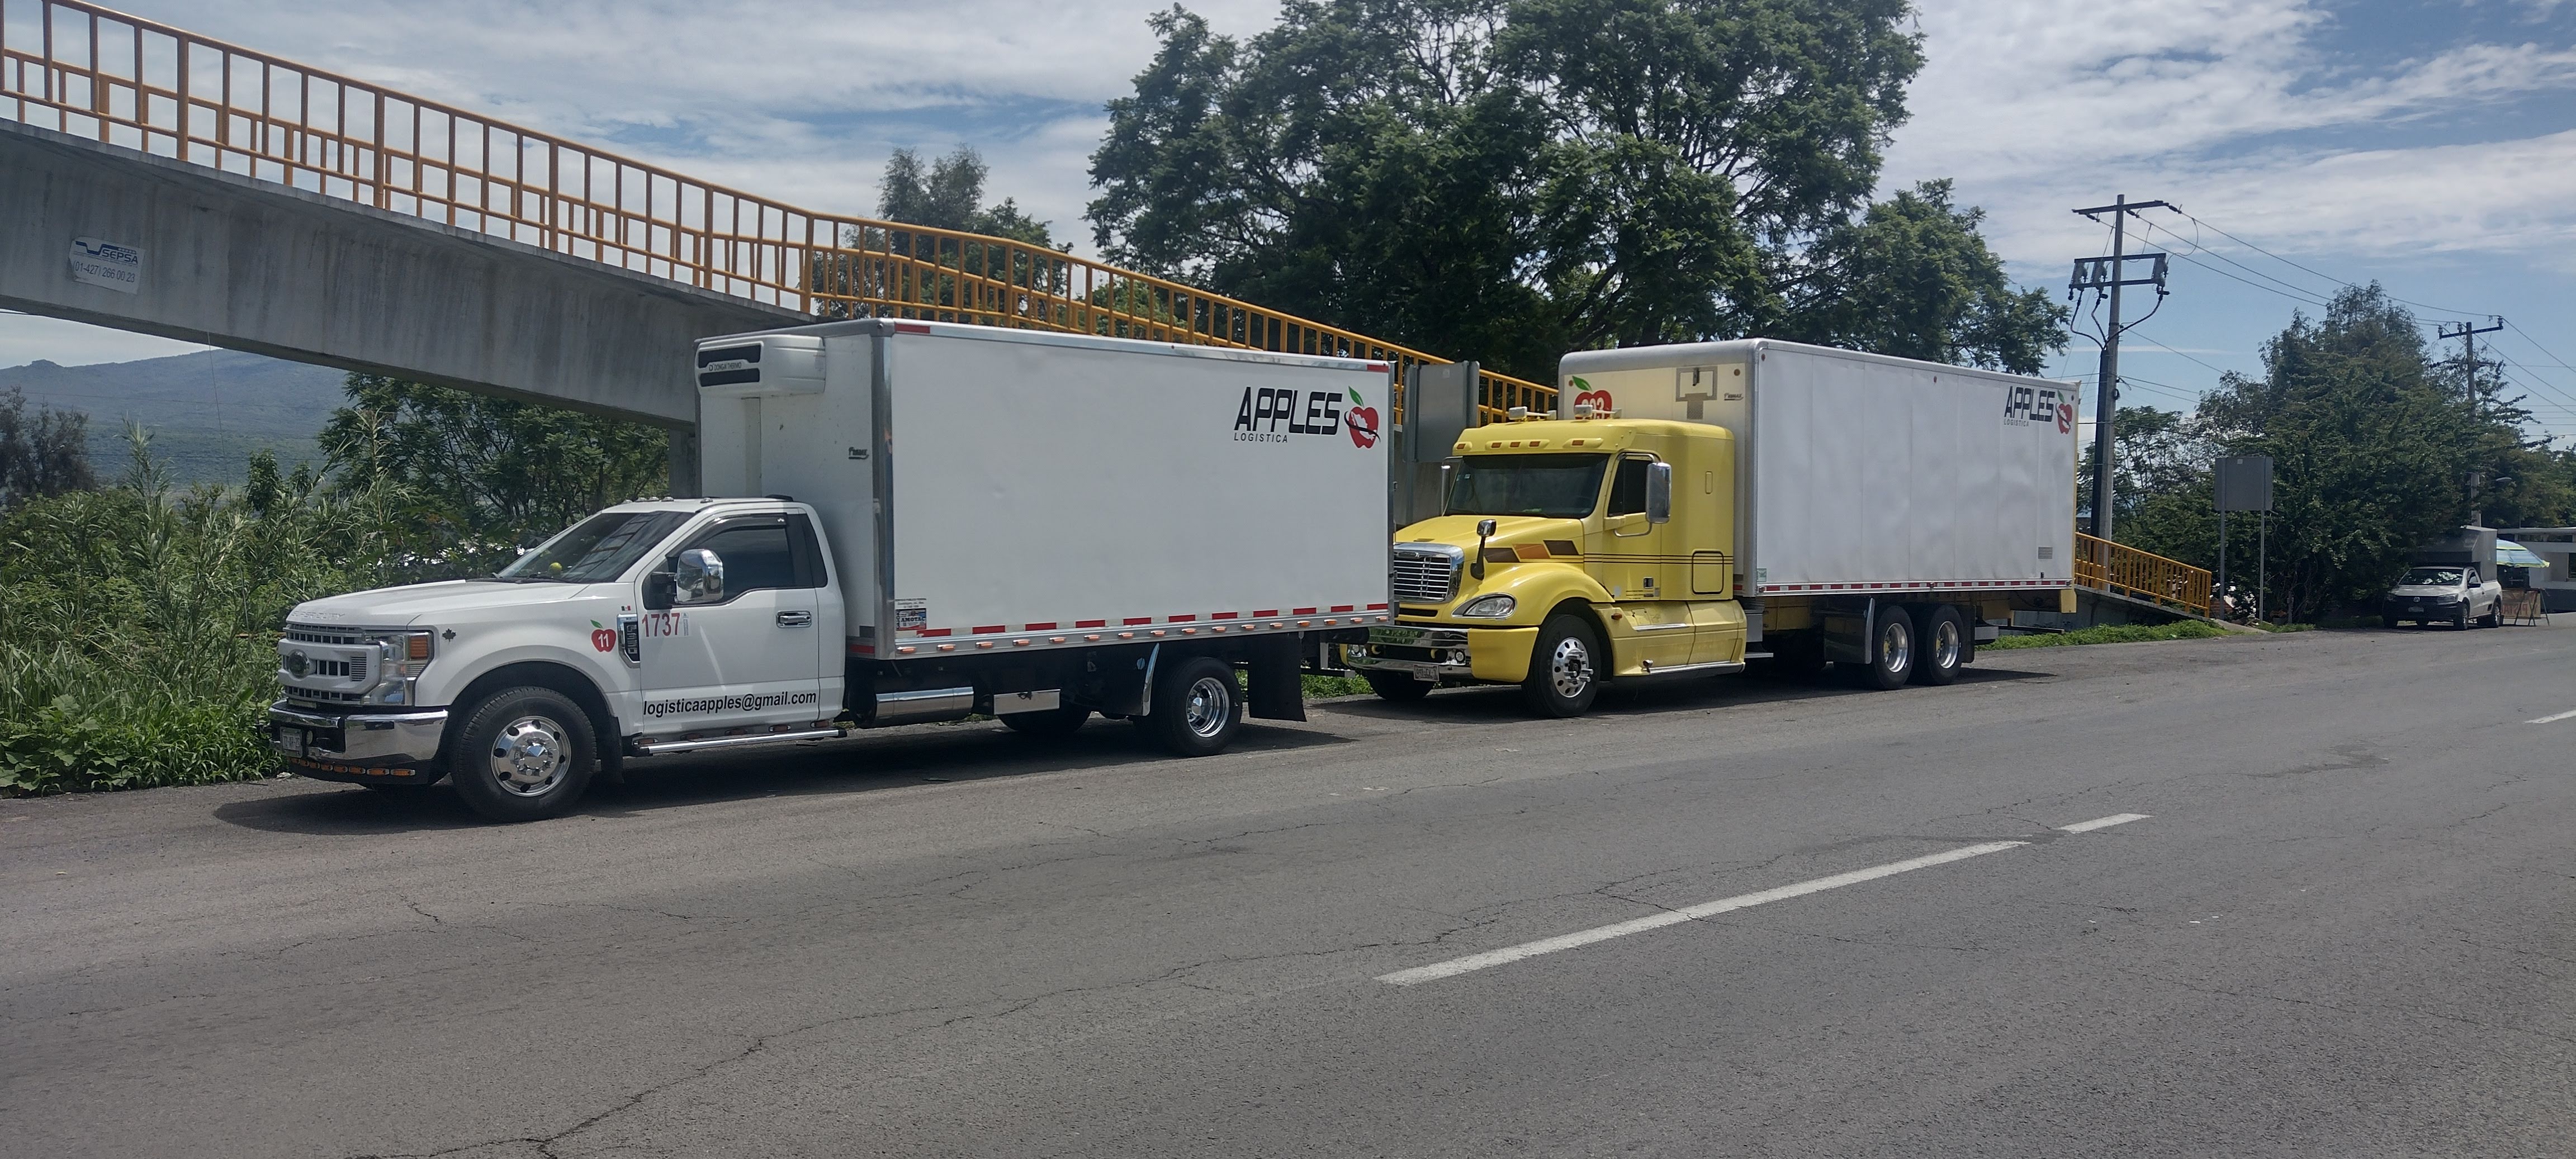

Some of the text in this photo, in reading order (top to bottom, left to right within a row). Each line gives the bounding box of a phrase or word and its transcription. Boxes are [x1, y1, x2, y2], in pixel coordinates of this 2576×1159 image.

[101, 249, 139, 264] SEPSA
[73, 261, 135, 283] (01-427) 266 00 23
[1234, 386, 1343, 435] APPLES
[2004, 386, 2056, 422] APPLES
[2004, 418, 2029, 427] LOGISTICA
[1234, 432, 1288, 443] LOGISTICA
[642, 612, 680, 637] 1737
[598, 633, 609, 648] 11
[643, 691, 816, 718] logisticaapples@gmail.com
